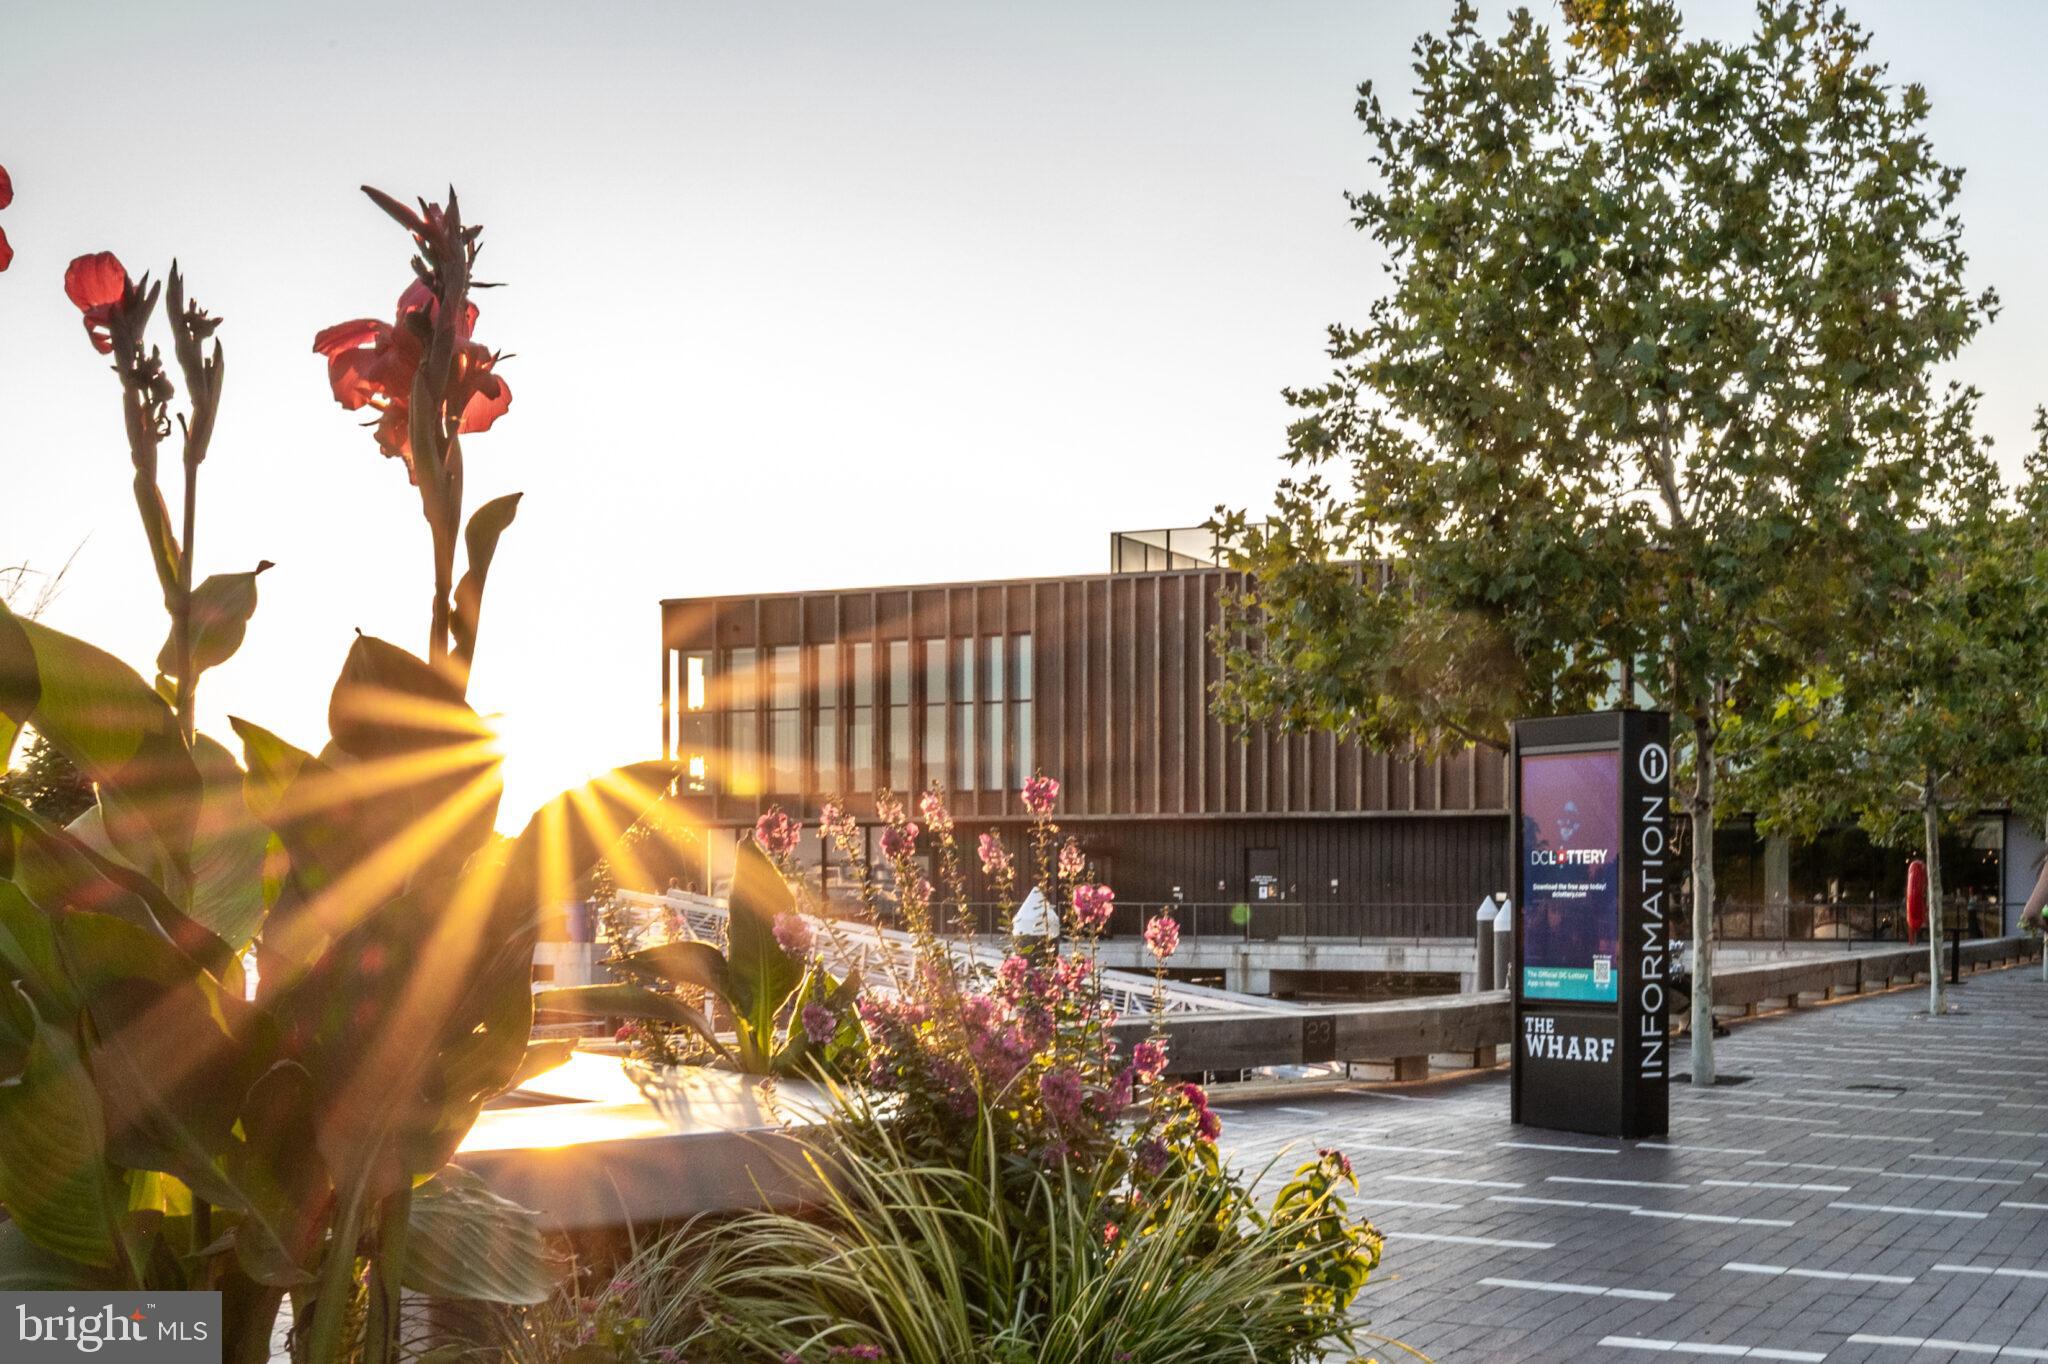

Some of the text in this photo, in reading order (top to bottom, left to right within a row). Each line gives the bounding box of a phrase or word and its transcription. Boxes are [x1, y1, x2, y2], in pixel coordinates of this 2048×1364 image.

[1641, 797, 1663, 1078] INFORMATION
[1525, 1017, 1554, 1033] THE
[1525, 1034, 1615, 1062] WHARF
